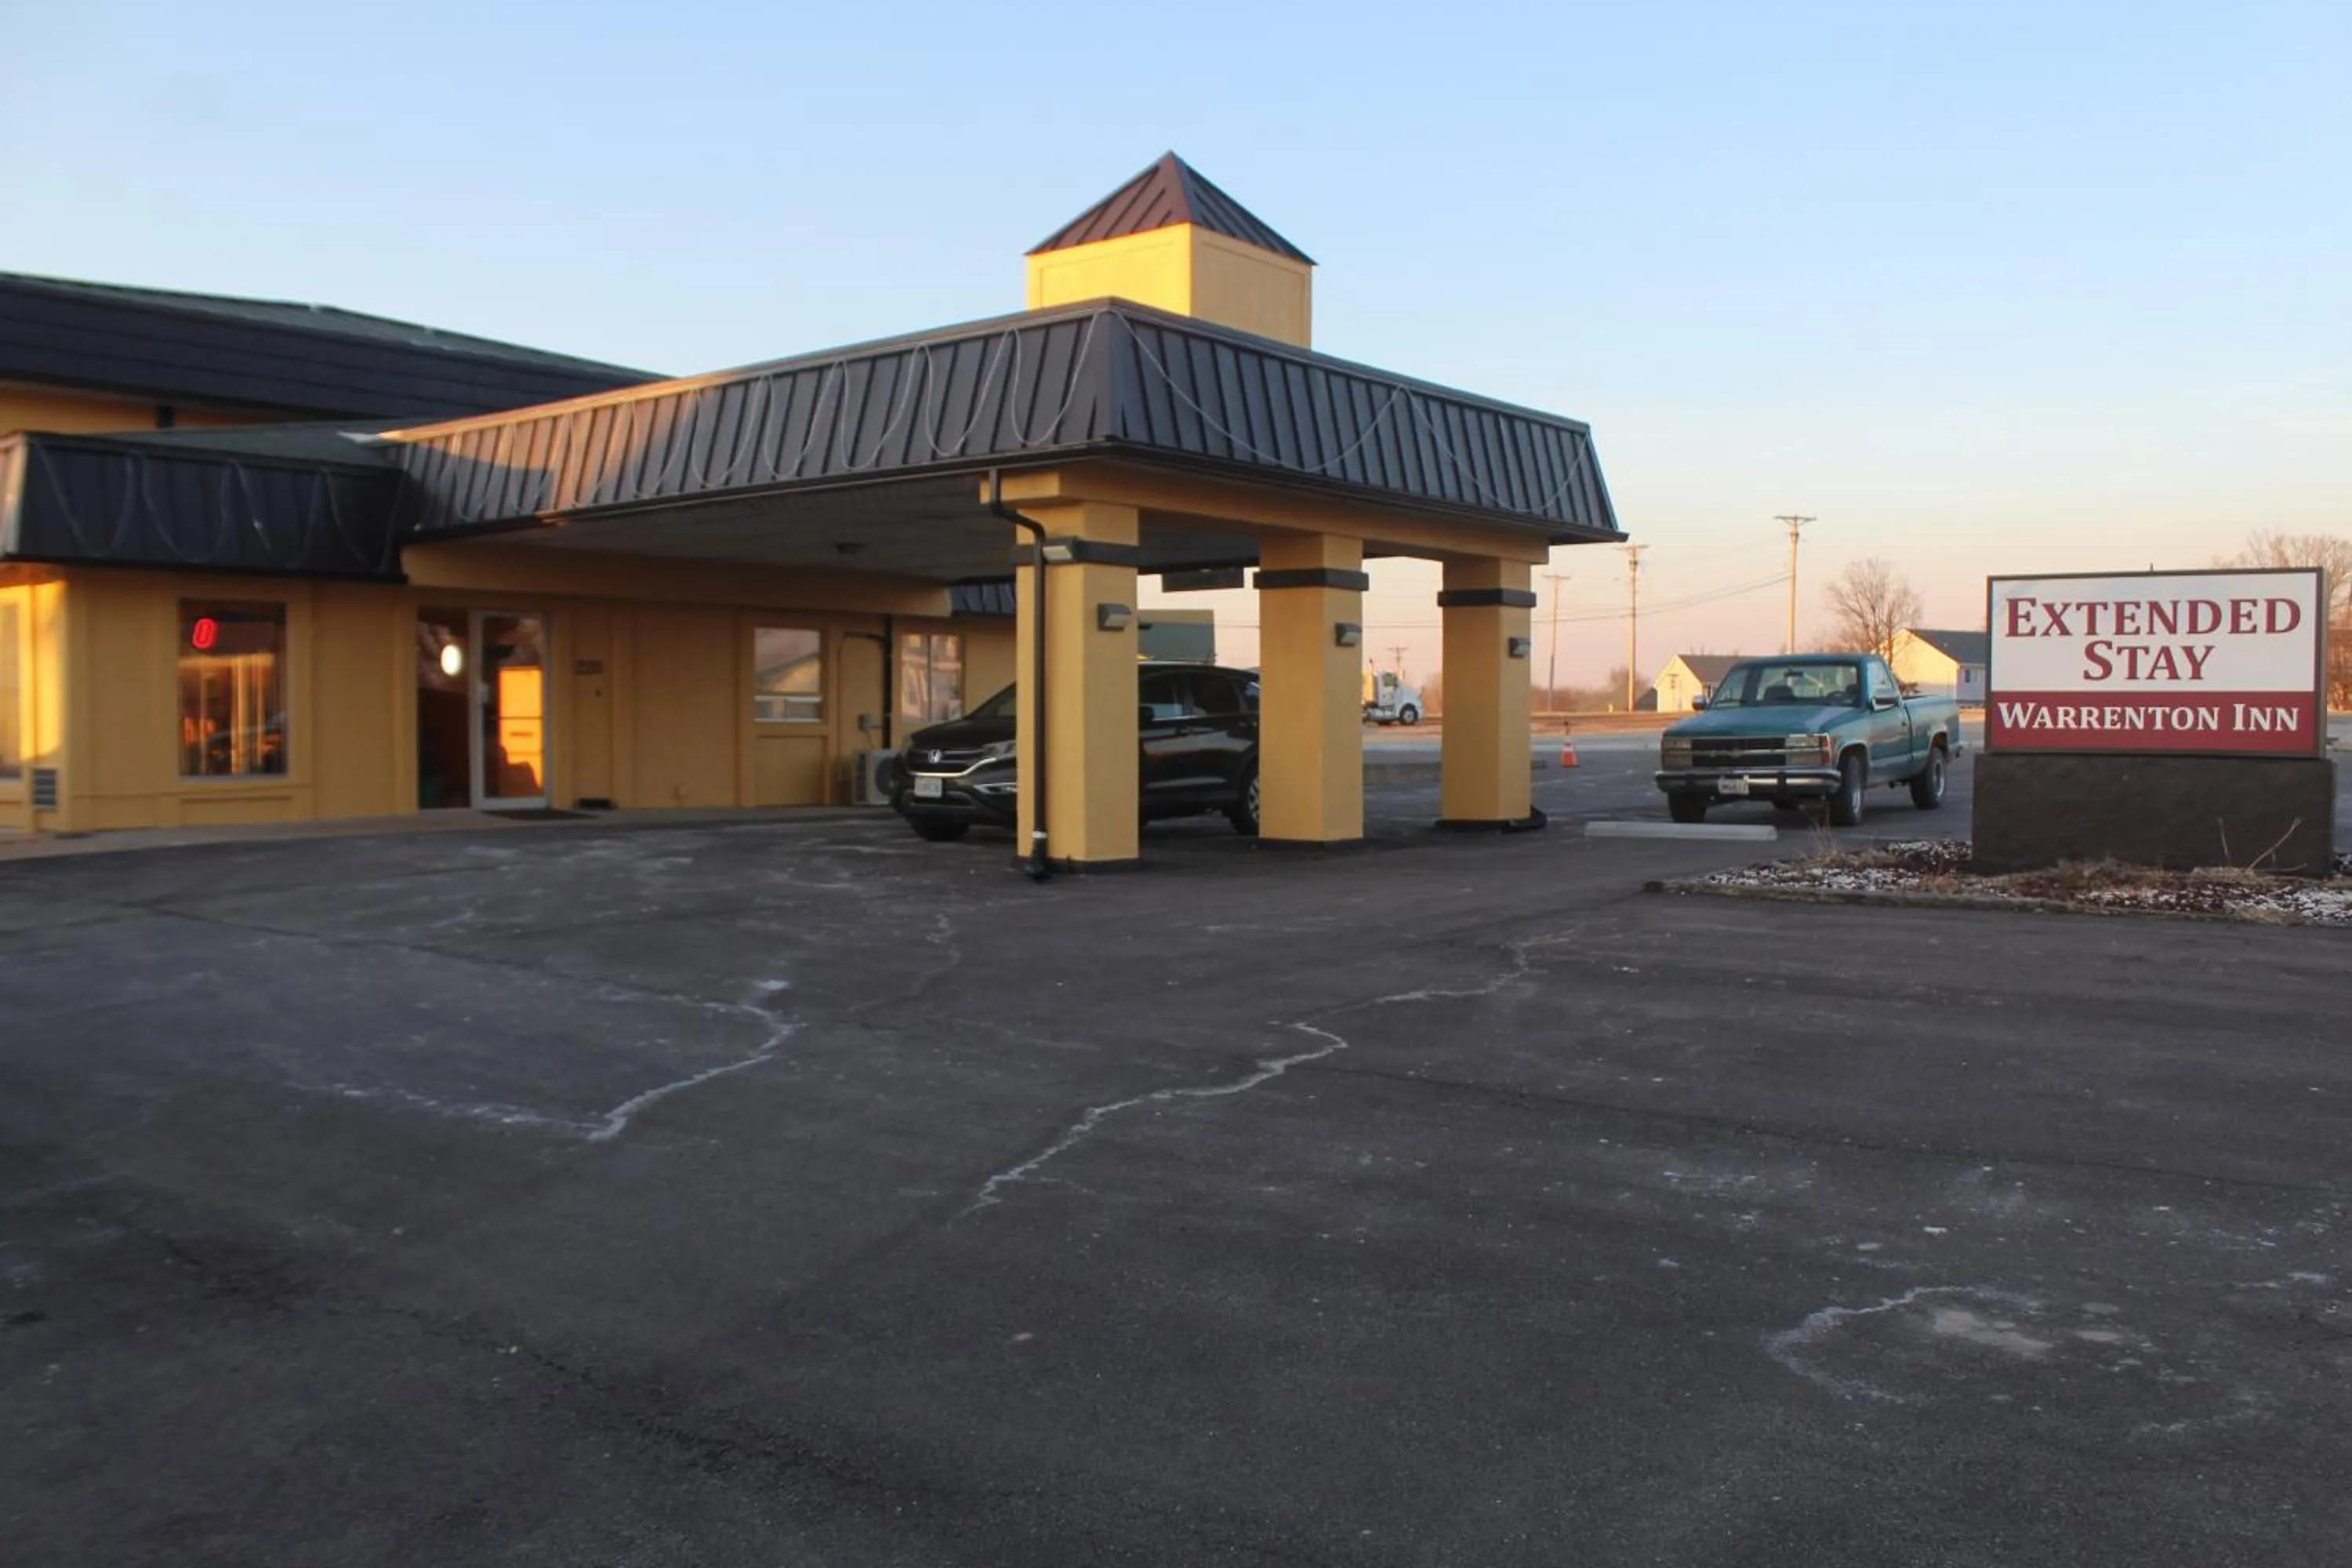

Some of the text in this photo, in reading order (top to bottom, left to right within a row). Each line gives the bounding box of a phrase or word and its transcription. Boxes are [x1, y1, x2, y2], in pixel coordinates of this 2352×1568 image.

[2005, 597, 2302, 637] EXTENDED
[2082, 639, 2216, 681] STAY
[1997, 702, 2299, 731] WARRENTON INN
